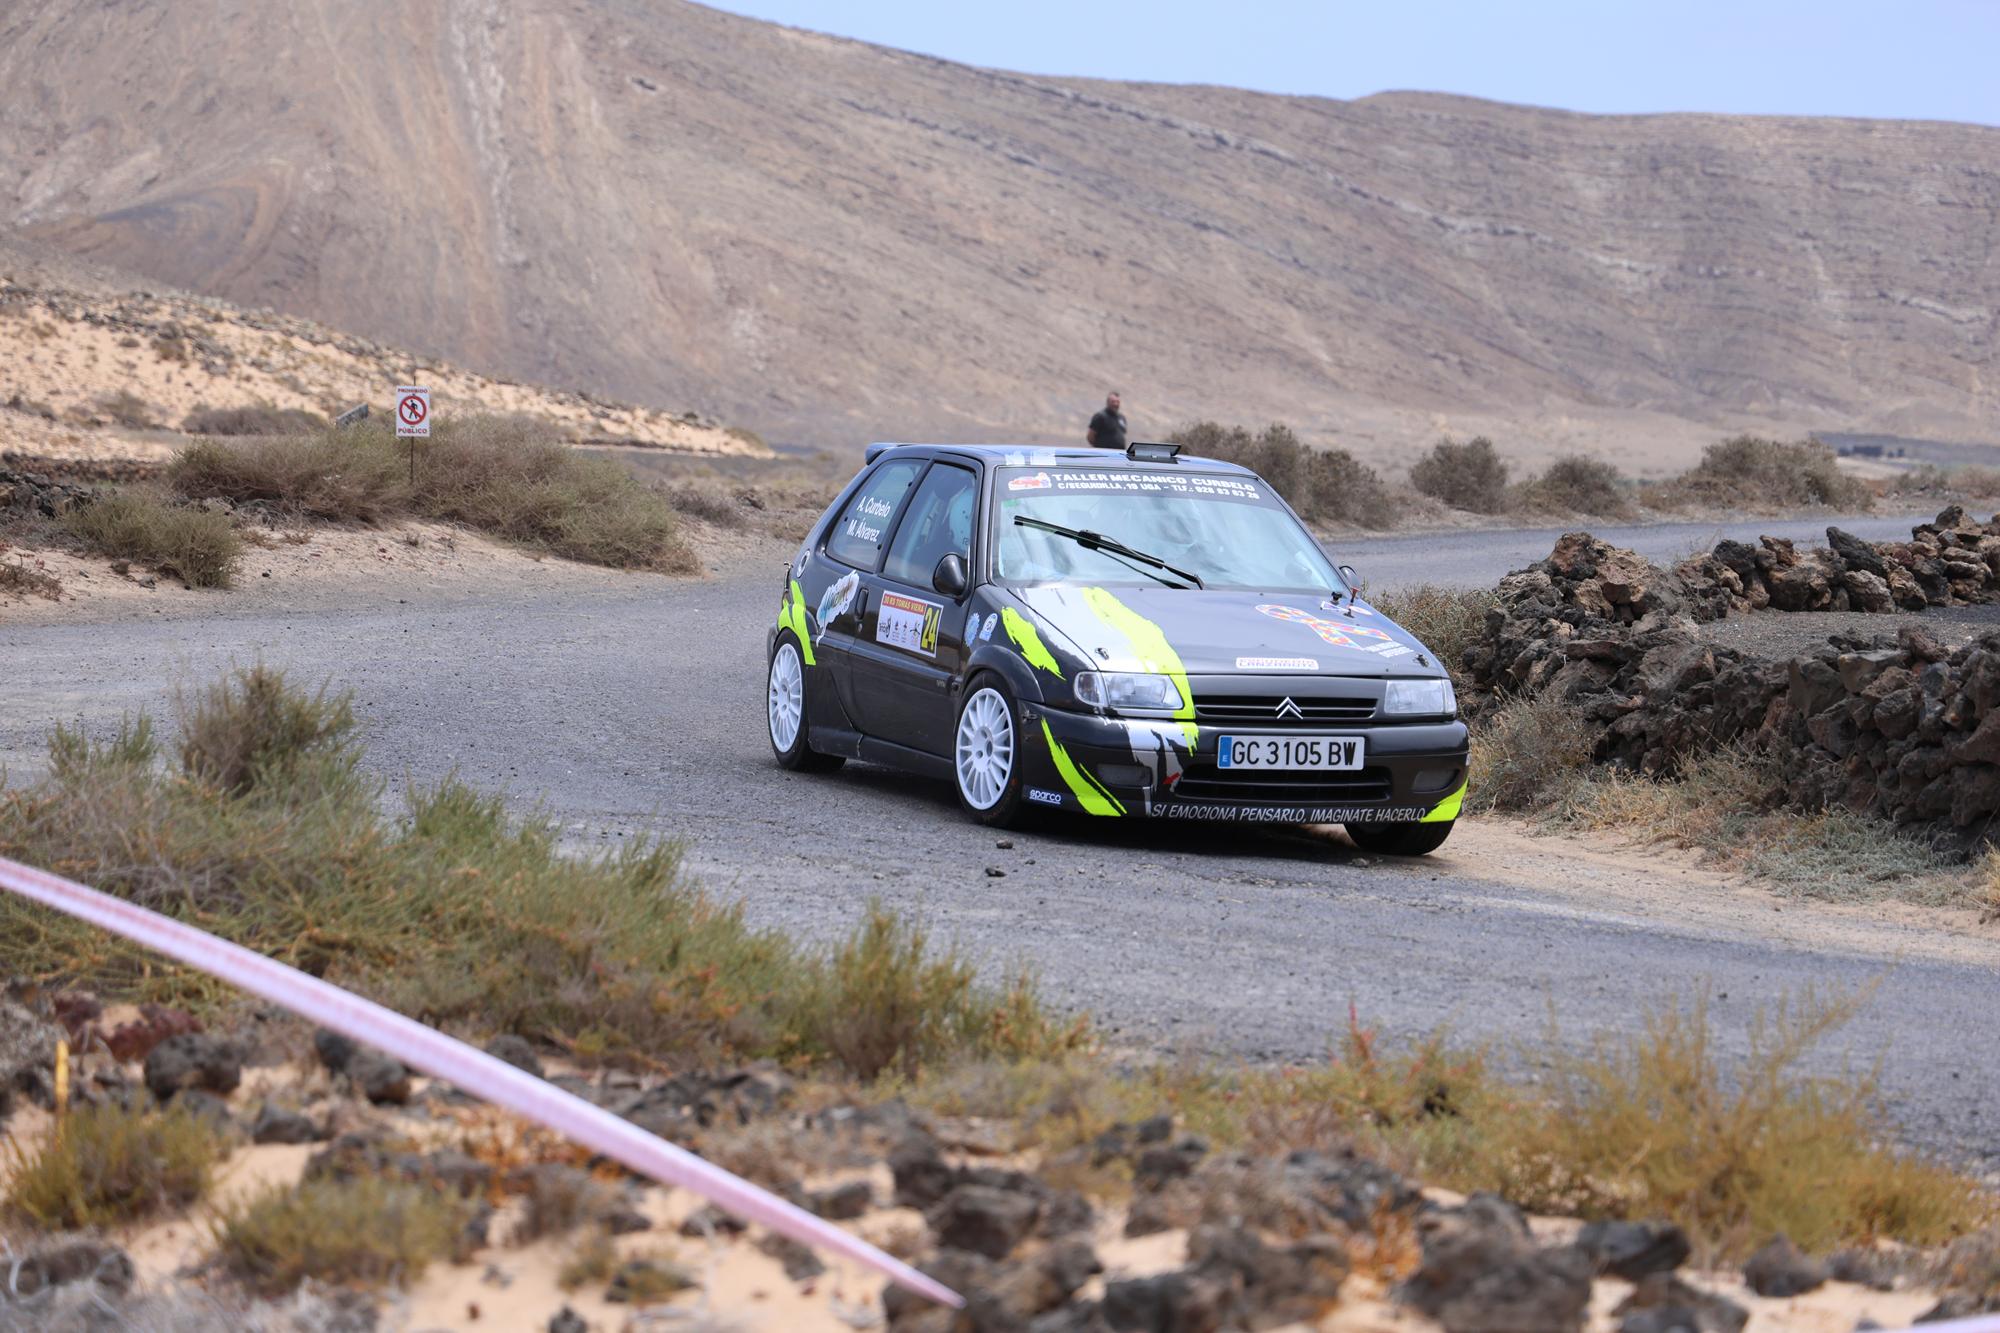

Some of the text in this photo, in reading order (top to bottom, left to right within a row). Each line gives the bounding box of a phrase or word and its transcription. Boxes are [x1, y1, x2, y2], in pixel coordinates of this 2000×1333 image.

[1052, 473, 1256, 492] TALLER MECANICO CURBELO
[857, 496, 891, 518] A. Curbelo
[855, 517, 880, 542] Álvarez
[921, 607, 940, 651] 24
[1232, 741, 1260, 765] GC
[1265, 741, 1322, 766] 3105
[1328, 742, 1357, 766] BW
[1030, 789, 1062, 802] sparco
[1151, 804, 1167, 818] SI
[1168, 804, 1236, 820] EMOCIONA
[1239, 807, 1307, 824] PENSARLO,
[1374, 807, 1426, 822] HACERLO
